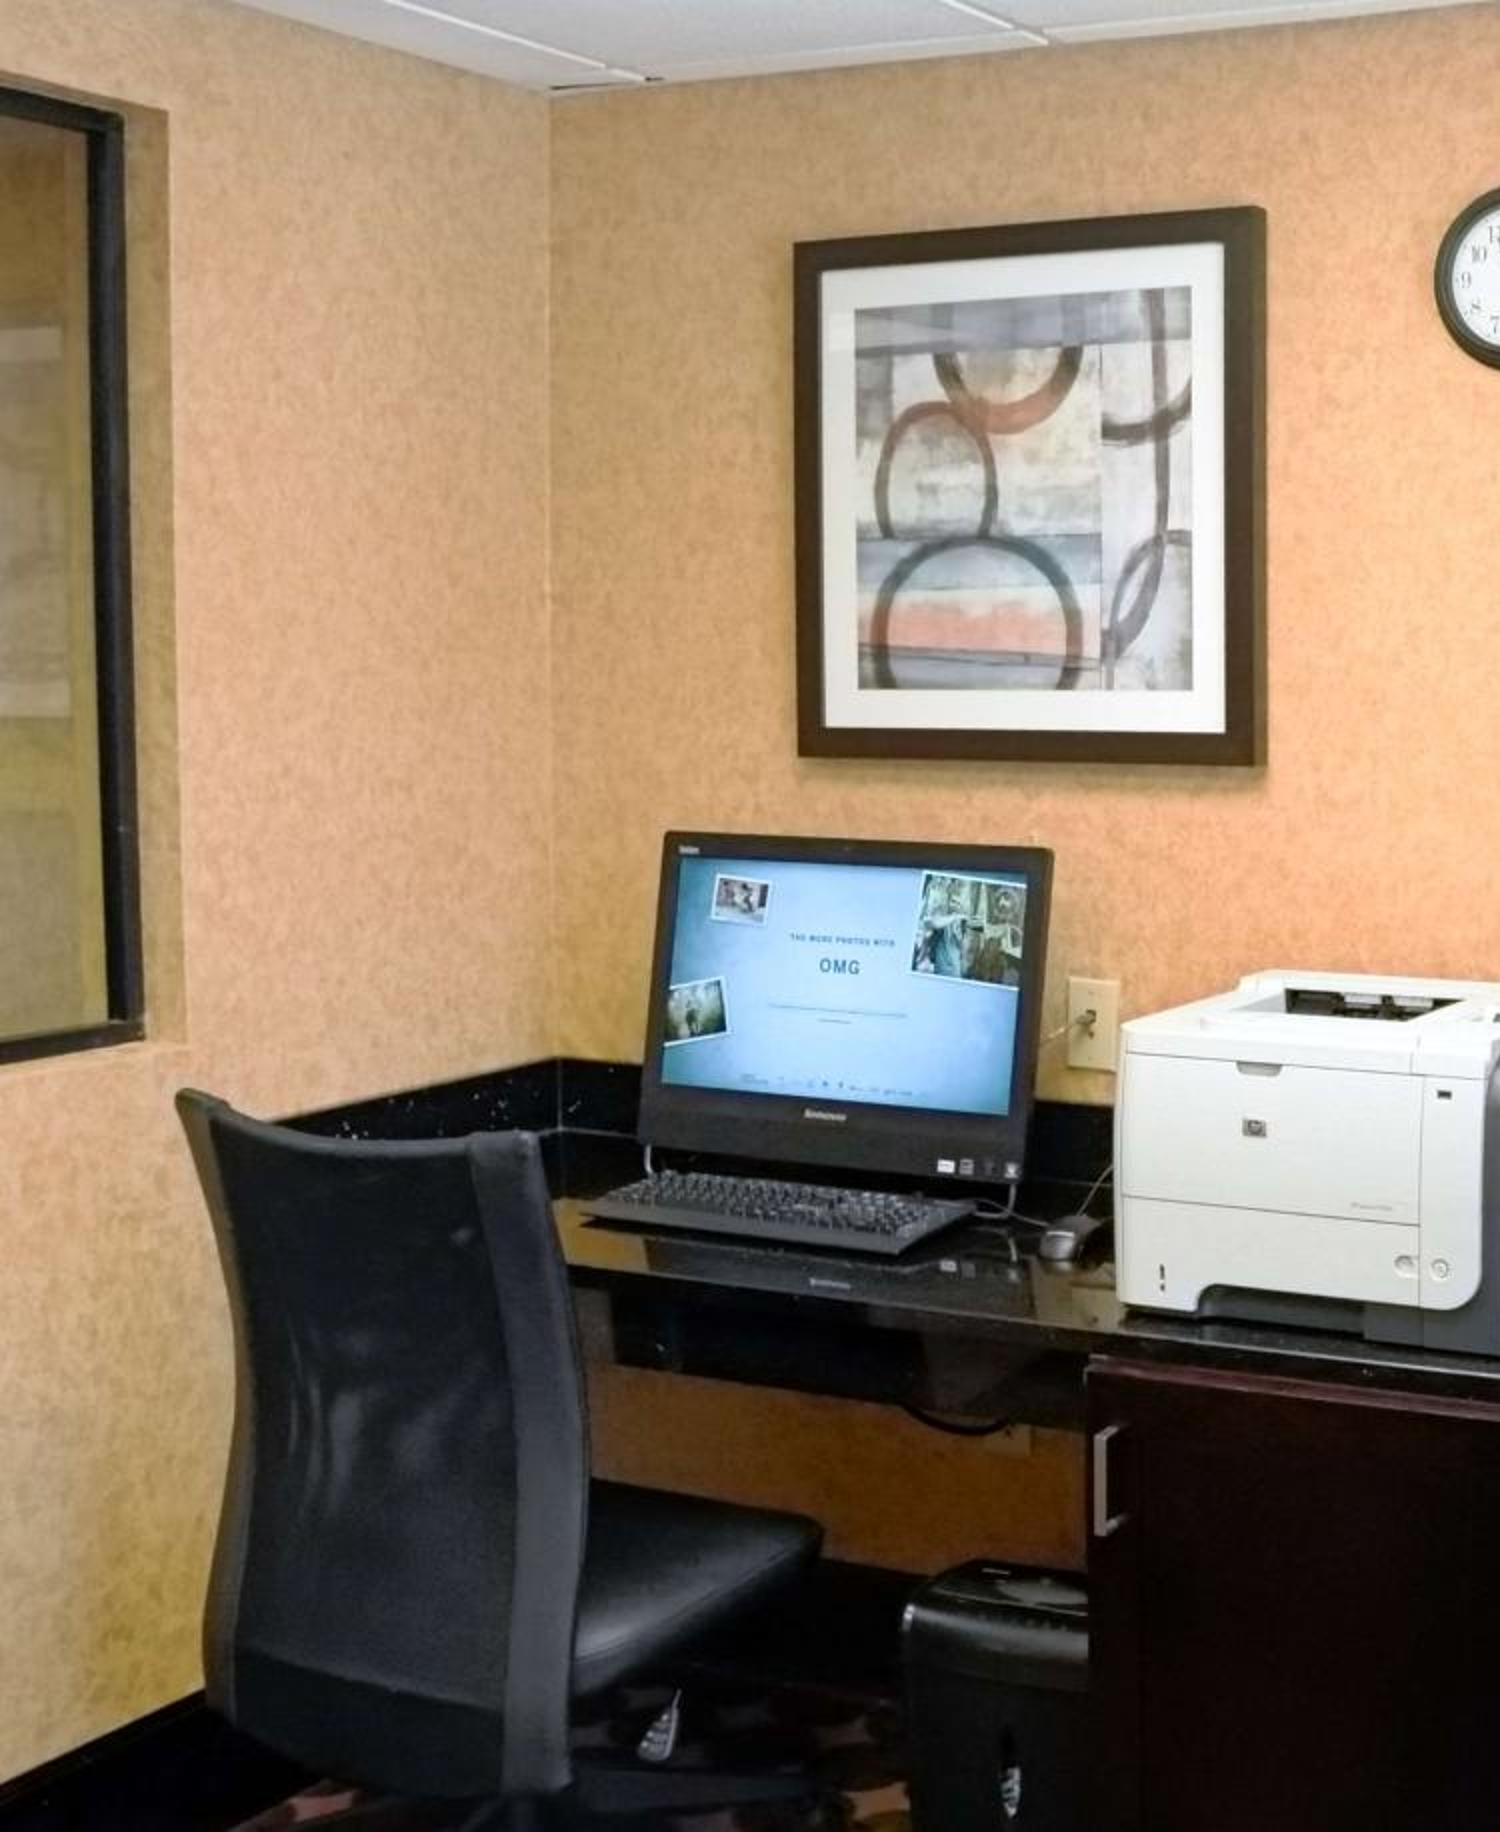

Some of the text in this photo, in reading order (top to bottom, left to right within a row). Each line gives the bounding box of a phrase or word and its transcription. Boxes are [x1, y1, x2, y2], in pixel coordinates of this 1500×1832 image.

[1471, 244, 1488, 264] 10
[1460, 270, 1473, 289] 9
[1489, 315, 1500, 334] 7
[819, 957, 861, 975] OMG
